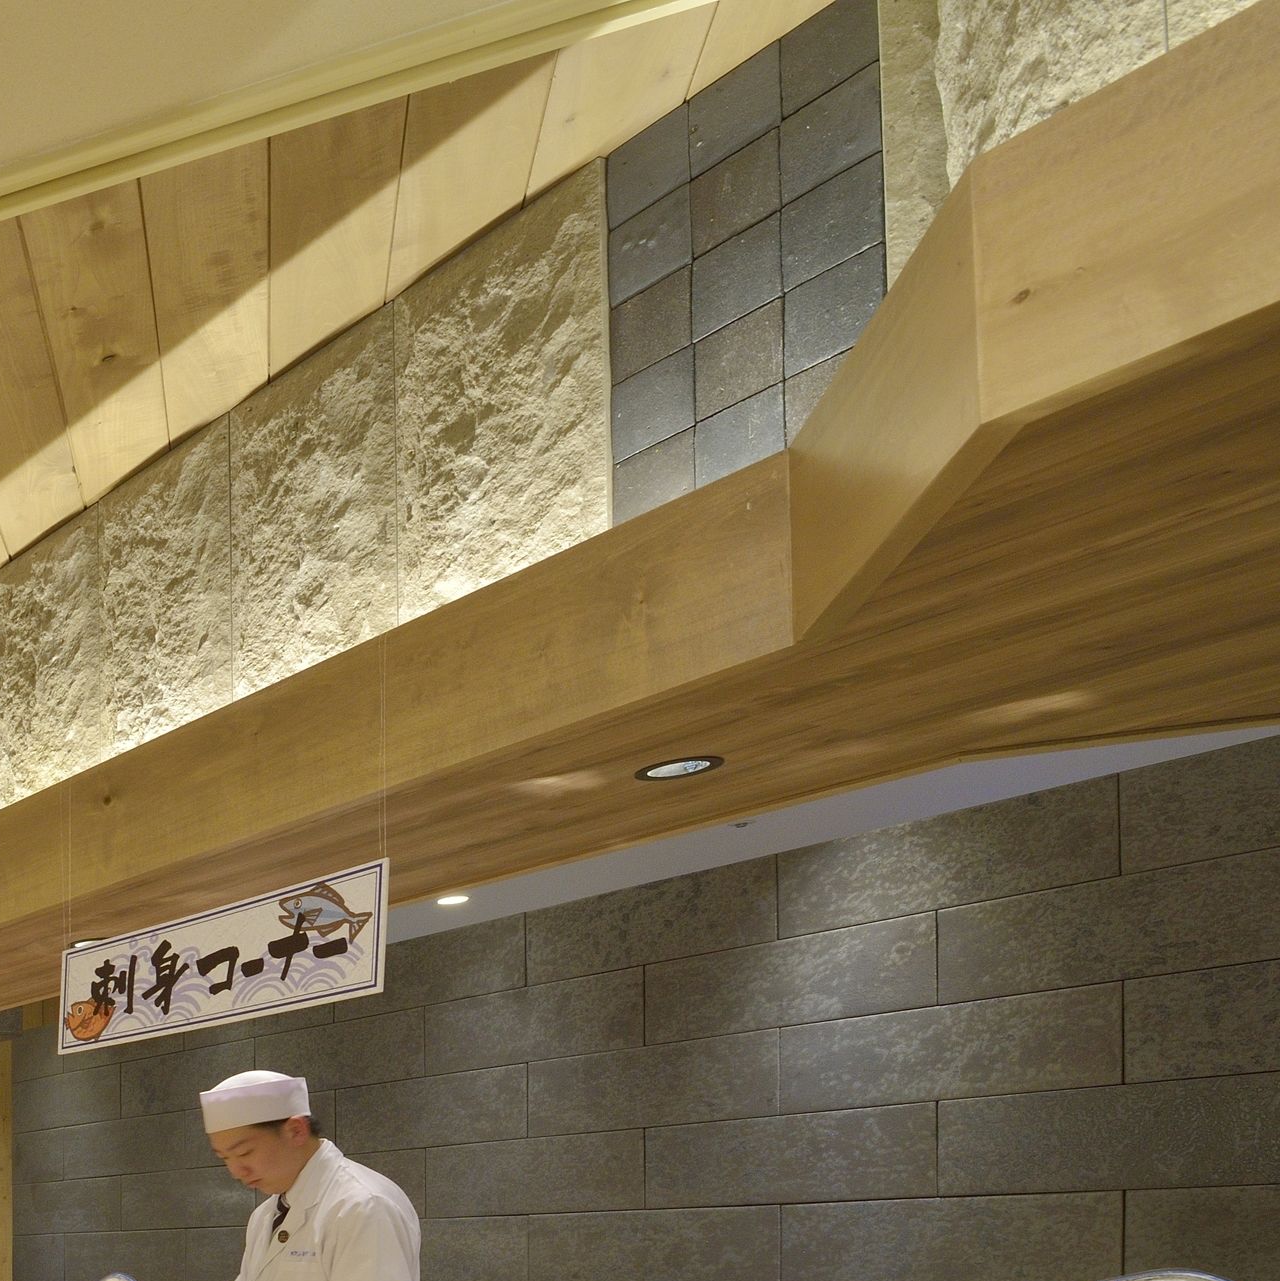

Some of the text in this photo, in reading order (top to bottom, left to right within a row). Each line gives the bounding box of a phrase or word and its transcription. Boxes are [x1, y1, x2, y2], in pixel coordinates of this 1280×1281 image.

[91, 912, 348, 1016] 刺身コーナー
